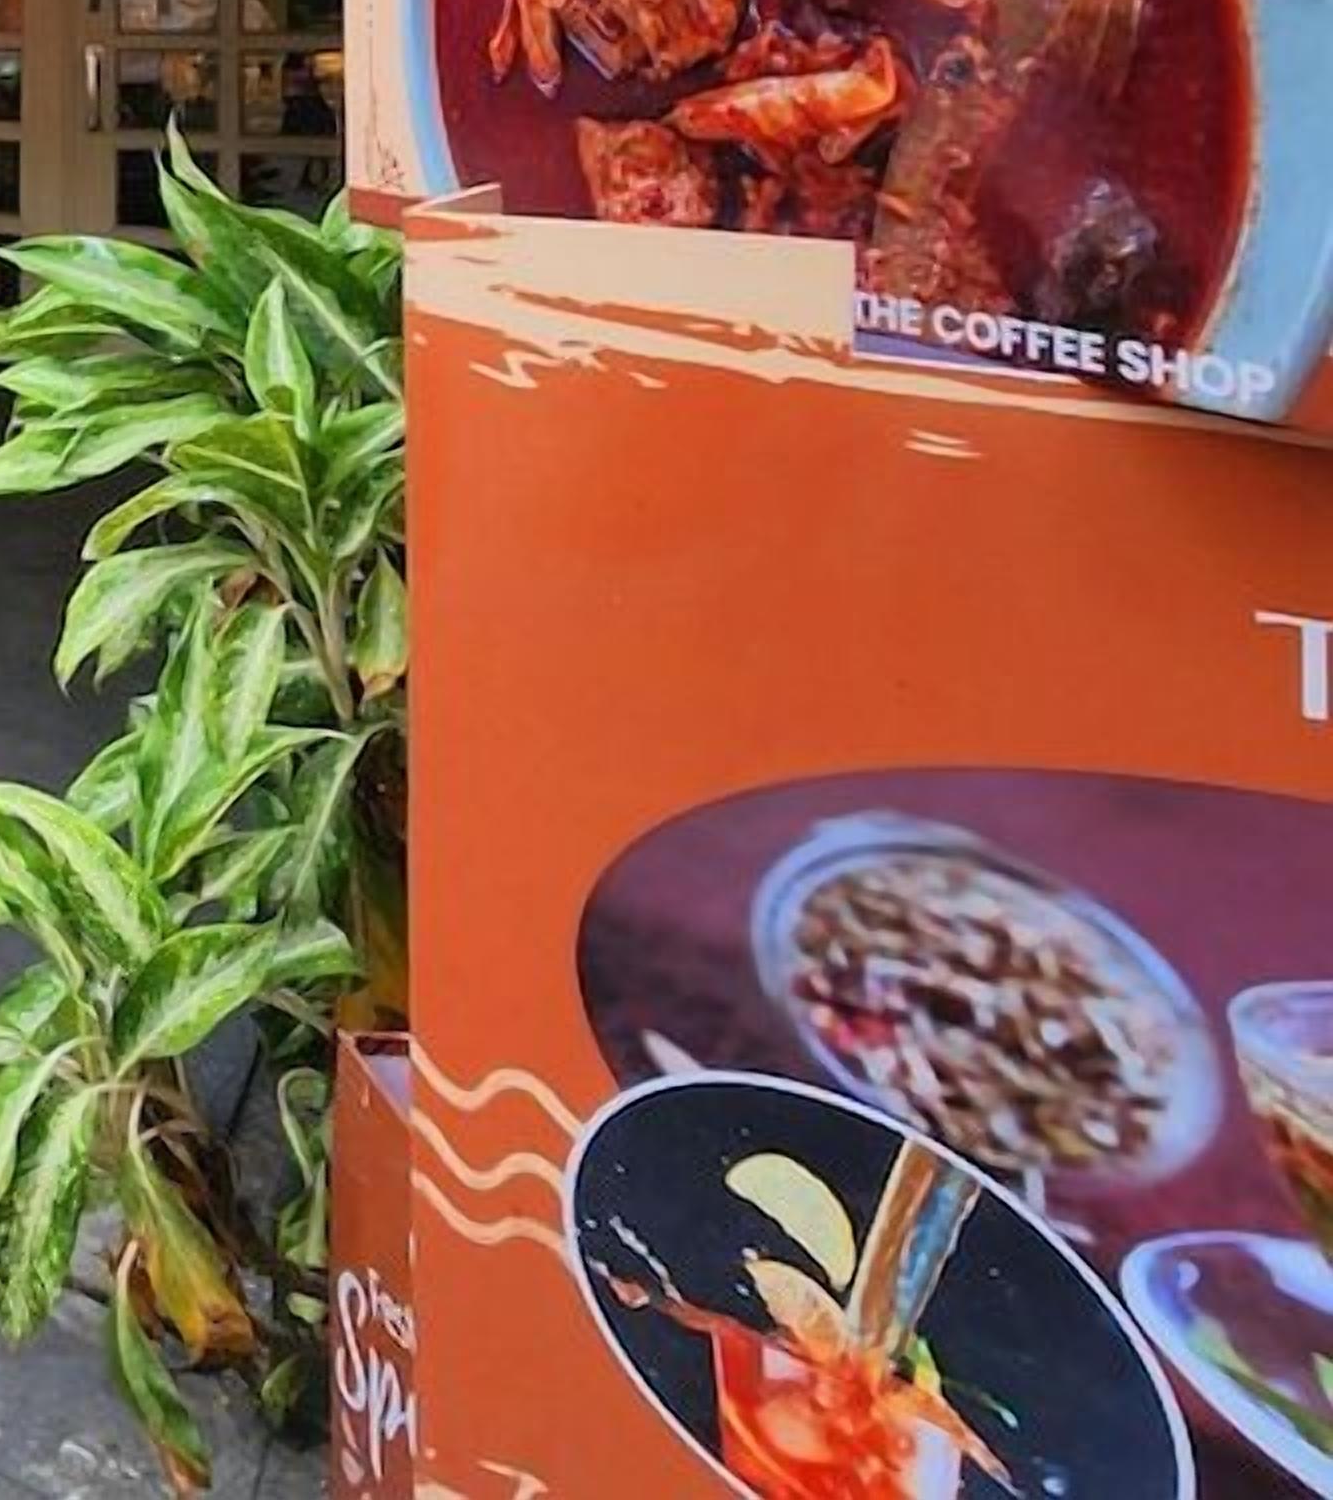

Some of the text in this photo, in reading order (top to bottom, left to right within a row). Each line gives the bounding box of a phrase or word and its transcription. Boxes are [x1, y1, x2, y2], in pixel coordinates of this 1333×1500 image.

[853, 290, 1276, 405] THE COFFEE SHOP
